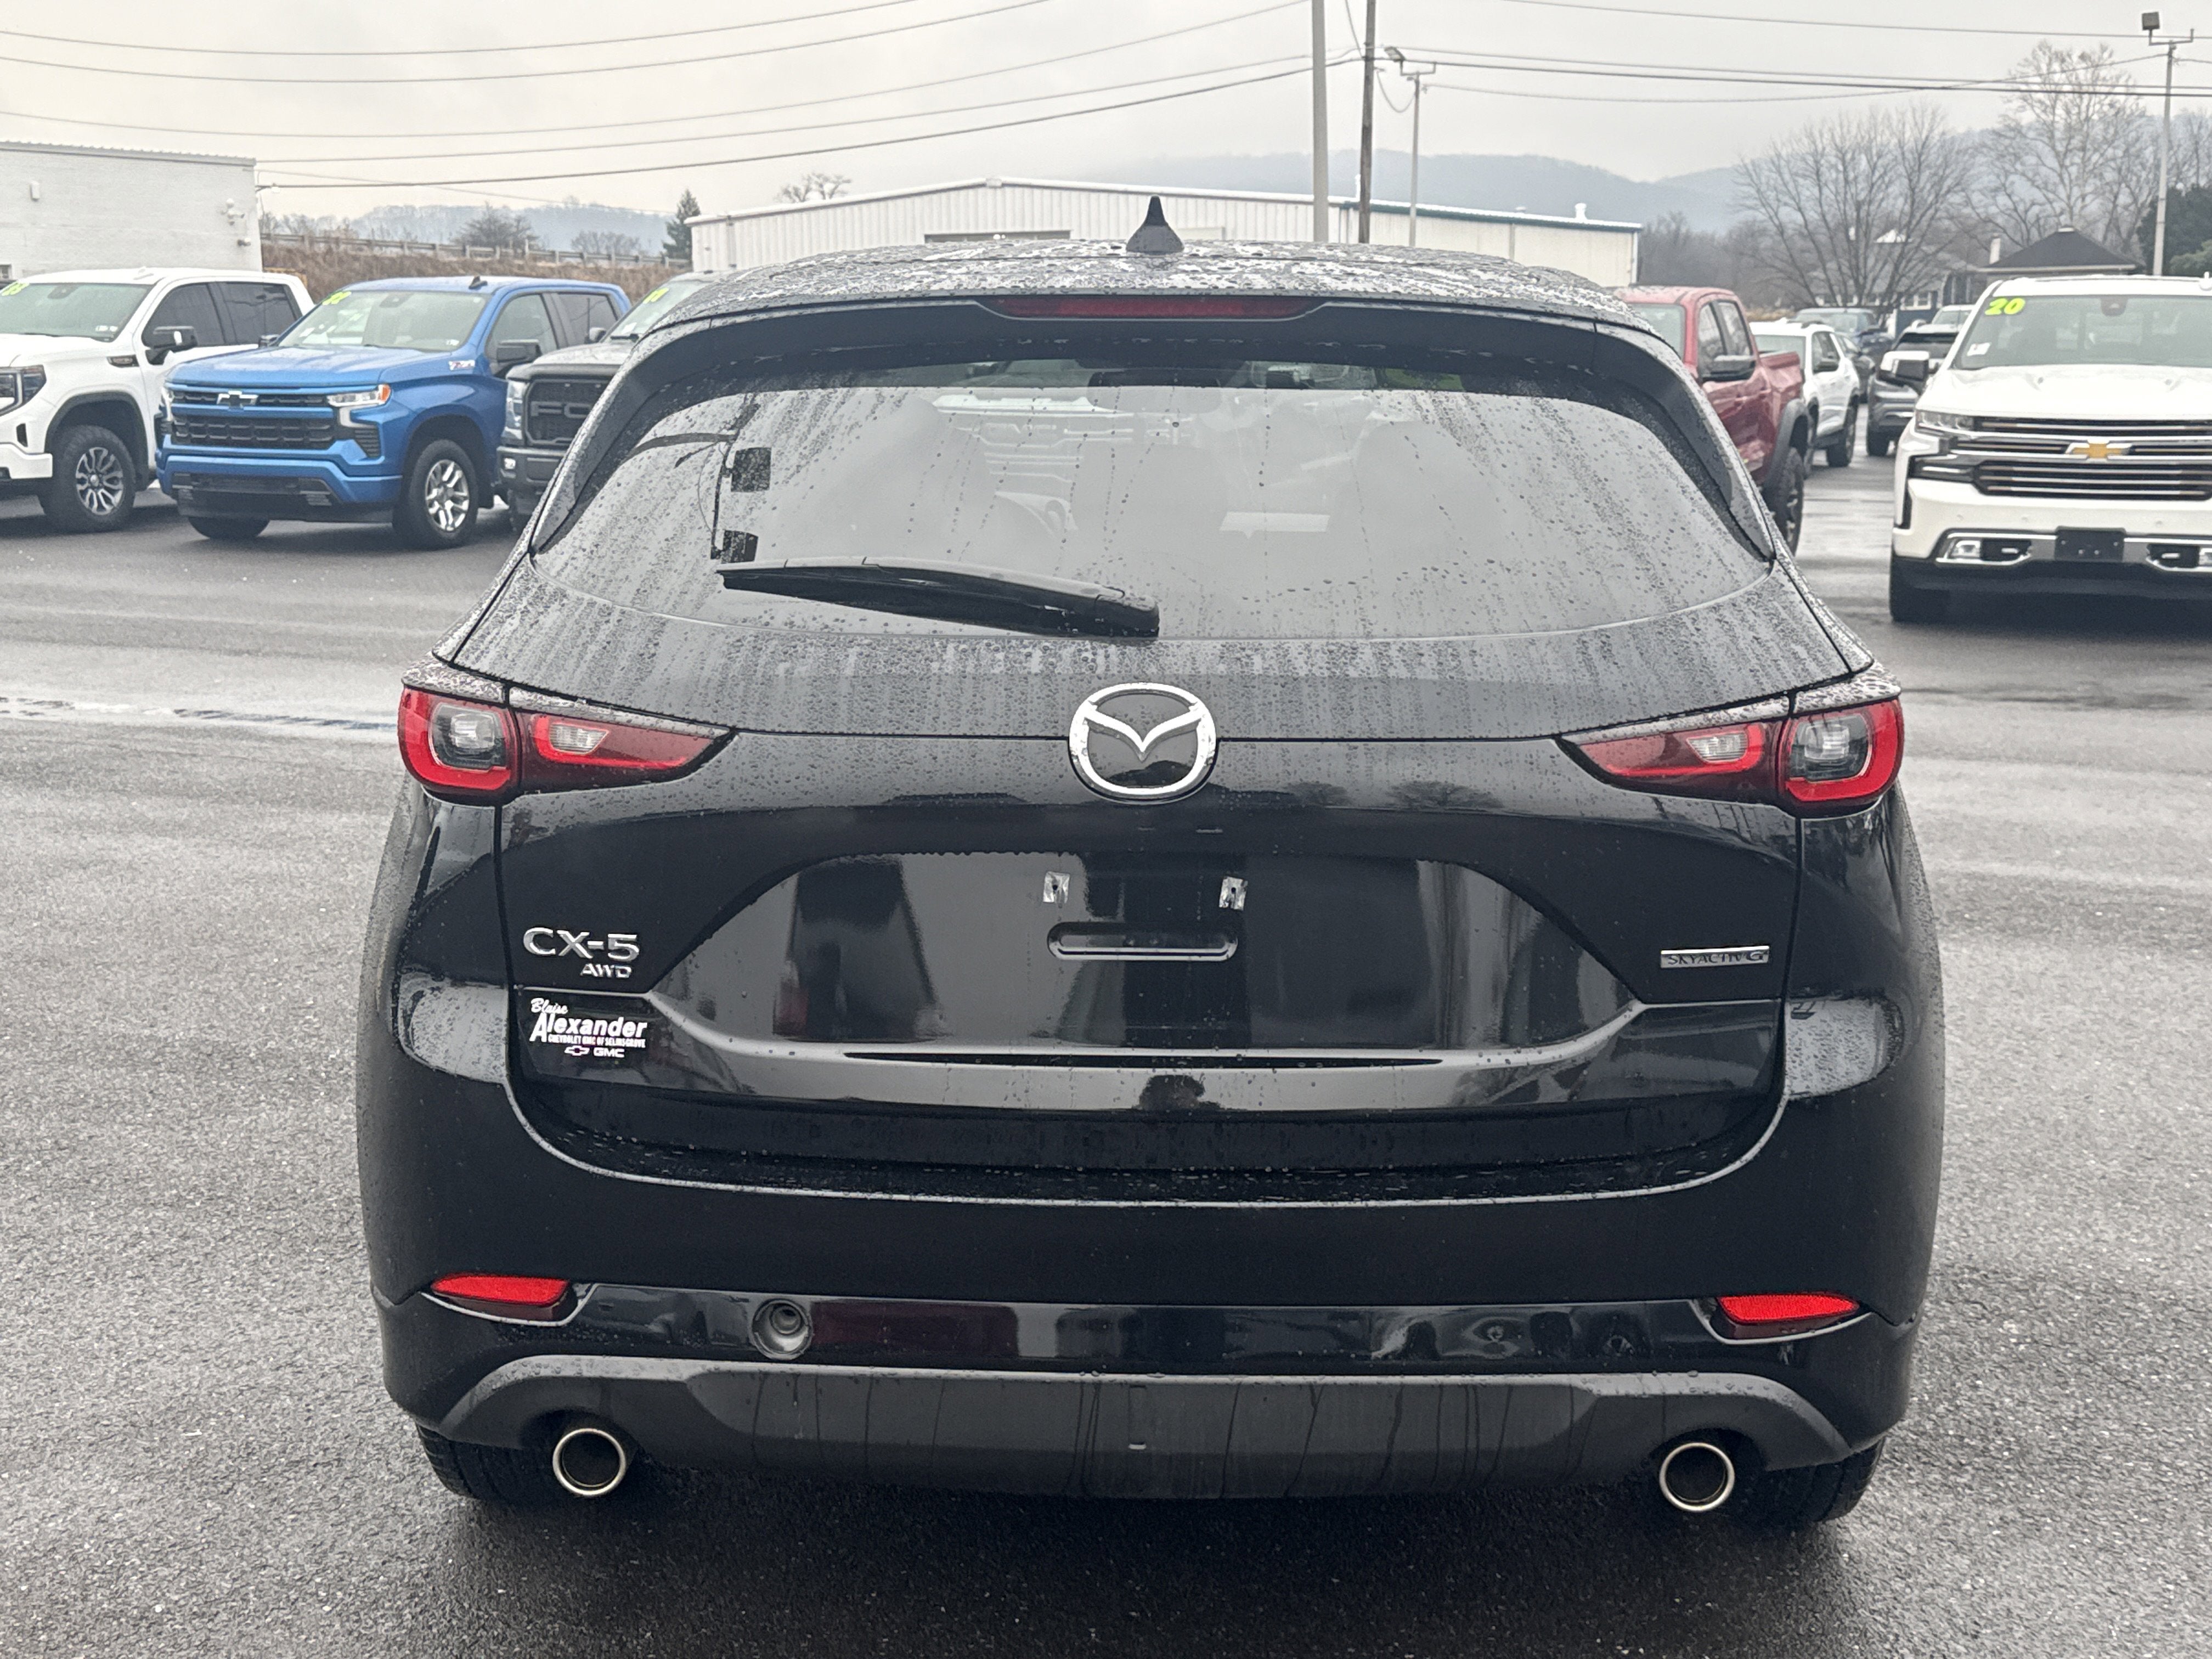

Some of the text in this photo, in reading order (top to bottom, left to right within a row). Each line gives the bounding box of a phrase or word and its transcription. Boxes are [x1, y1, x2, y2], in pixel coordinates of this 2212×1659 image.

[1984, 297, 2025, 315] 20
[531, 401, 592, 418] FO
[523, 927, 640, 961] CX-5
[580, 963, 631, 978] AWD
[531, 998, 568, 1014] Blaise
[529, 1013, 648, 1042] Alexander
[593, 1047, 625, 1058] GMC
